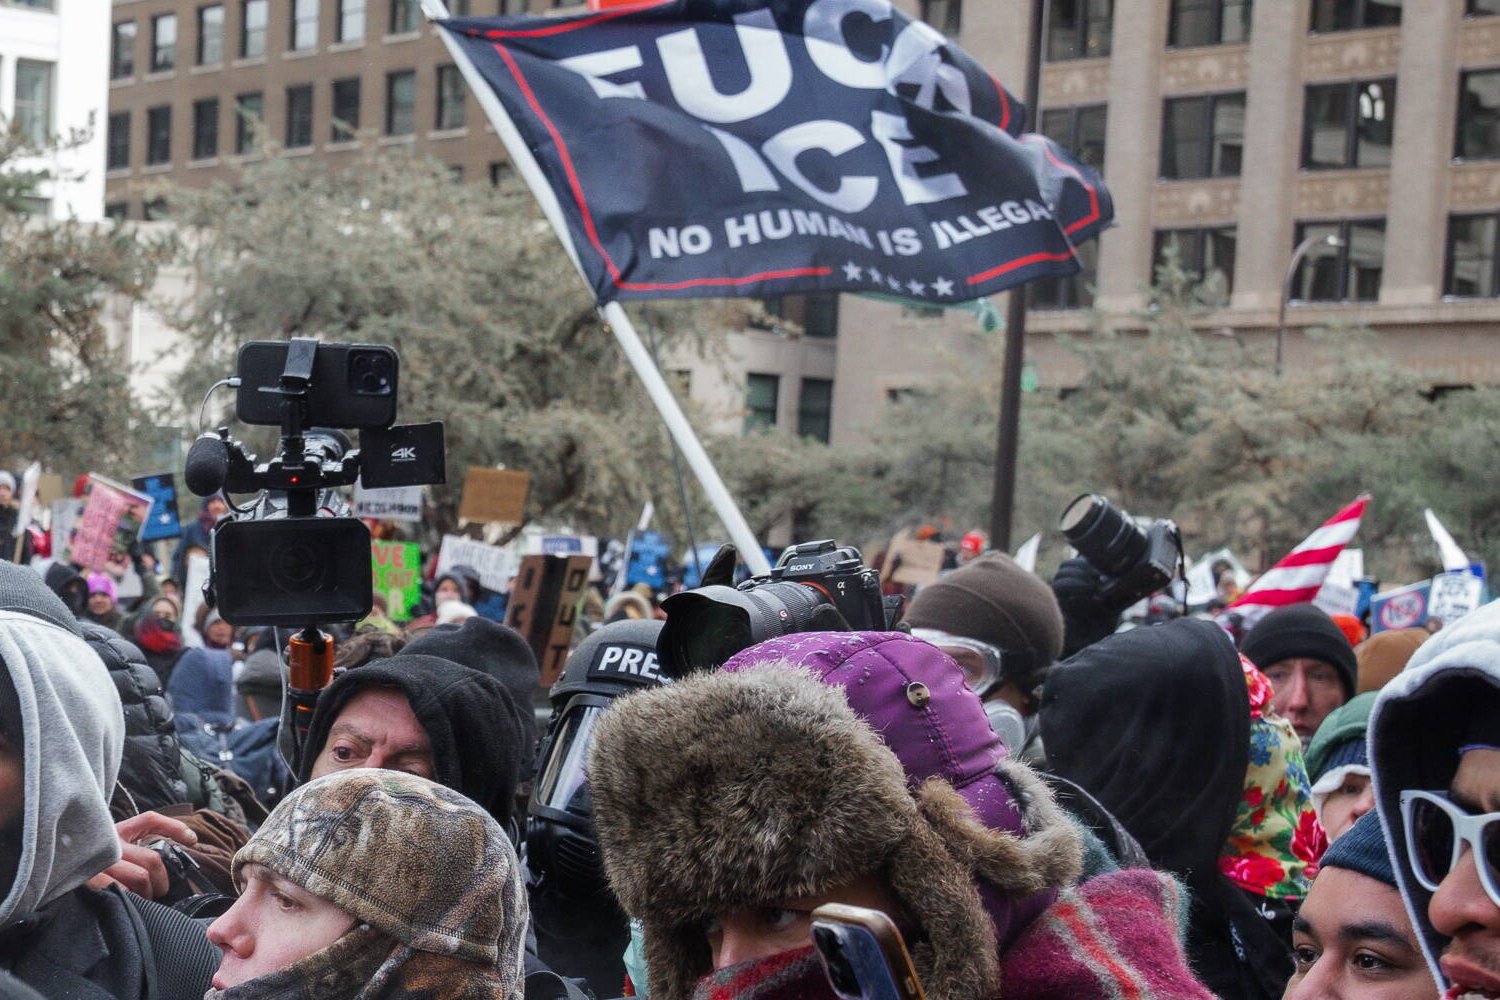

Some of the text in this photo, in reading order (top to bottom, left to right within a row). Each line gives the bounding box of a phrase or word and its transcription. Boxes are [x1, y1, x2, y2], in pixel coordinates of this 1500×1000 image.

[703, 110, 970, 213] ICE
[648, 199, 1056, 259] NO HUMAN IS ILLEGA
[391, 447, 417, 458] 4K
[790, 563, 815, 571] SONY
[598, 646, 675, 685] PRE
